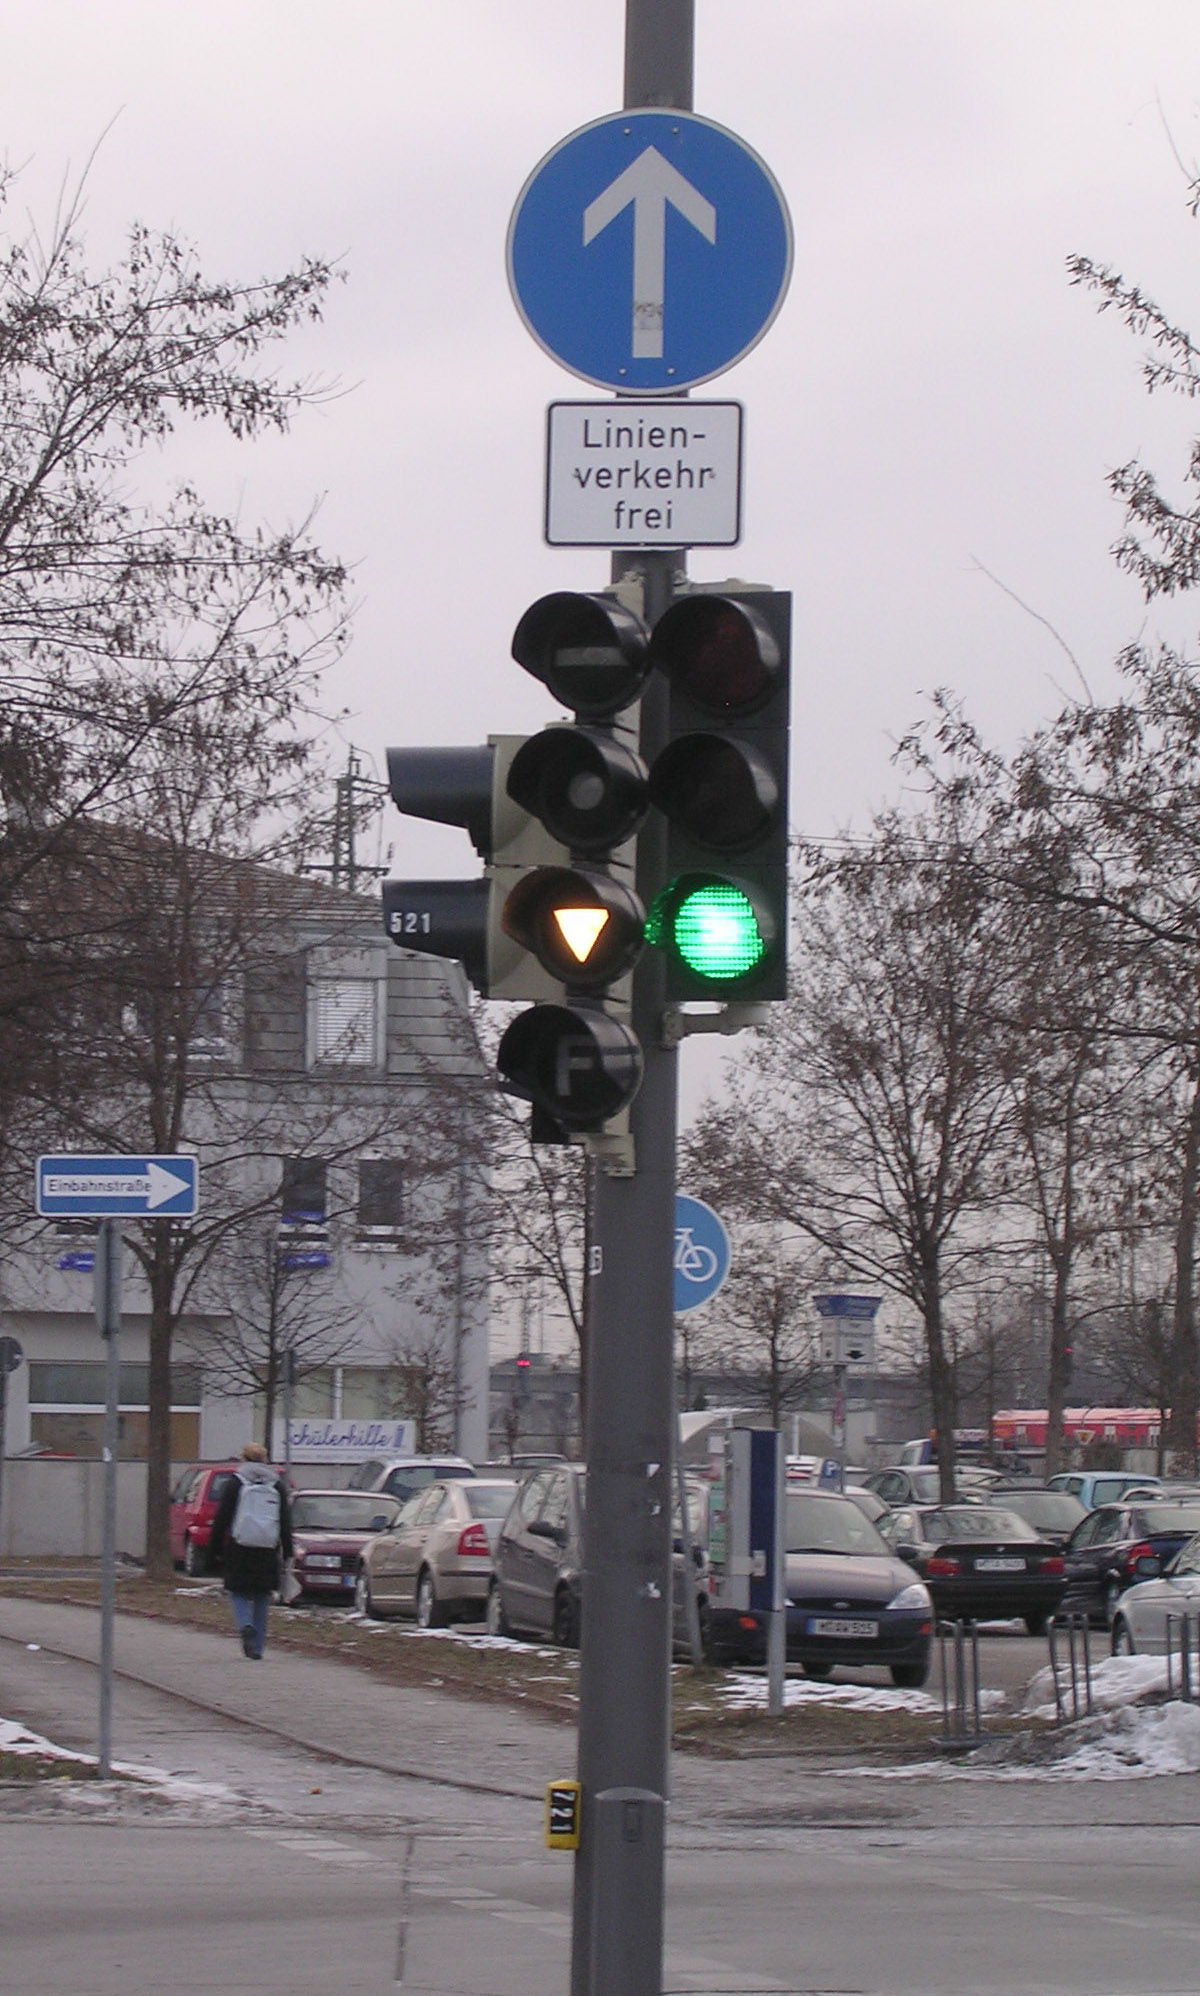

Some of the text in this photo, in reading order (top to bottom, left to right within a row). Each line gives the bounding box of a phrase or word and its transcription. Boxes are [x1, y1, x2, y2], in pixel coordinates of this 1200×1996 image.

[583, 418, 706, 449] Linien-
[573, 459, 714, 489] verkehr
[614, 500, 673, 530] frei
[390, 911, 431, 934] 521
[48, 1178, 152, 1193] Einbahnstraße
